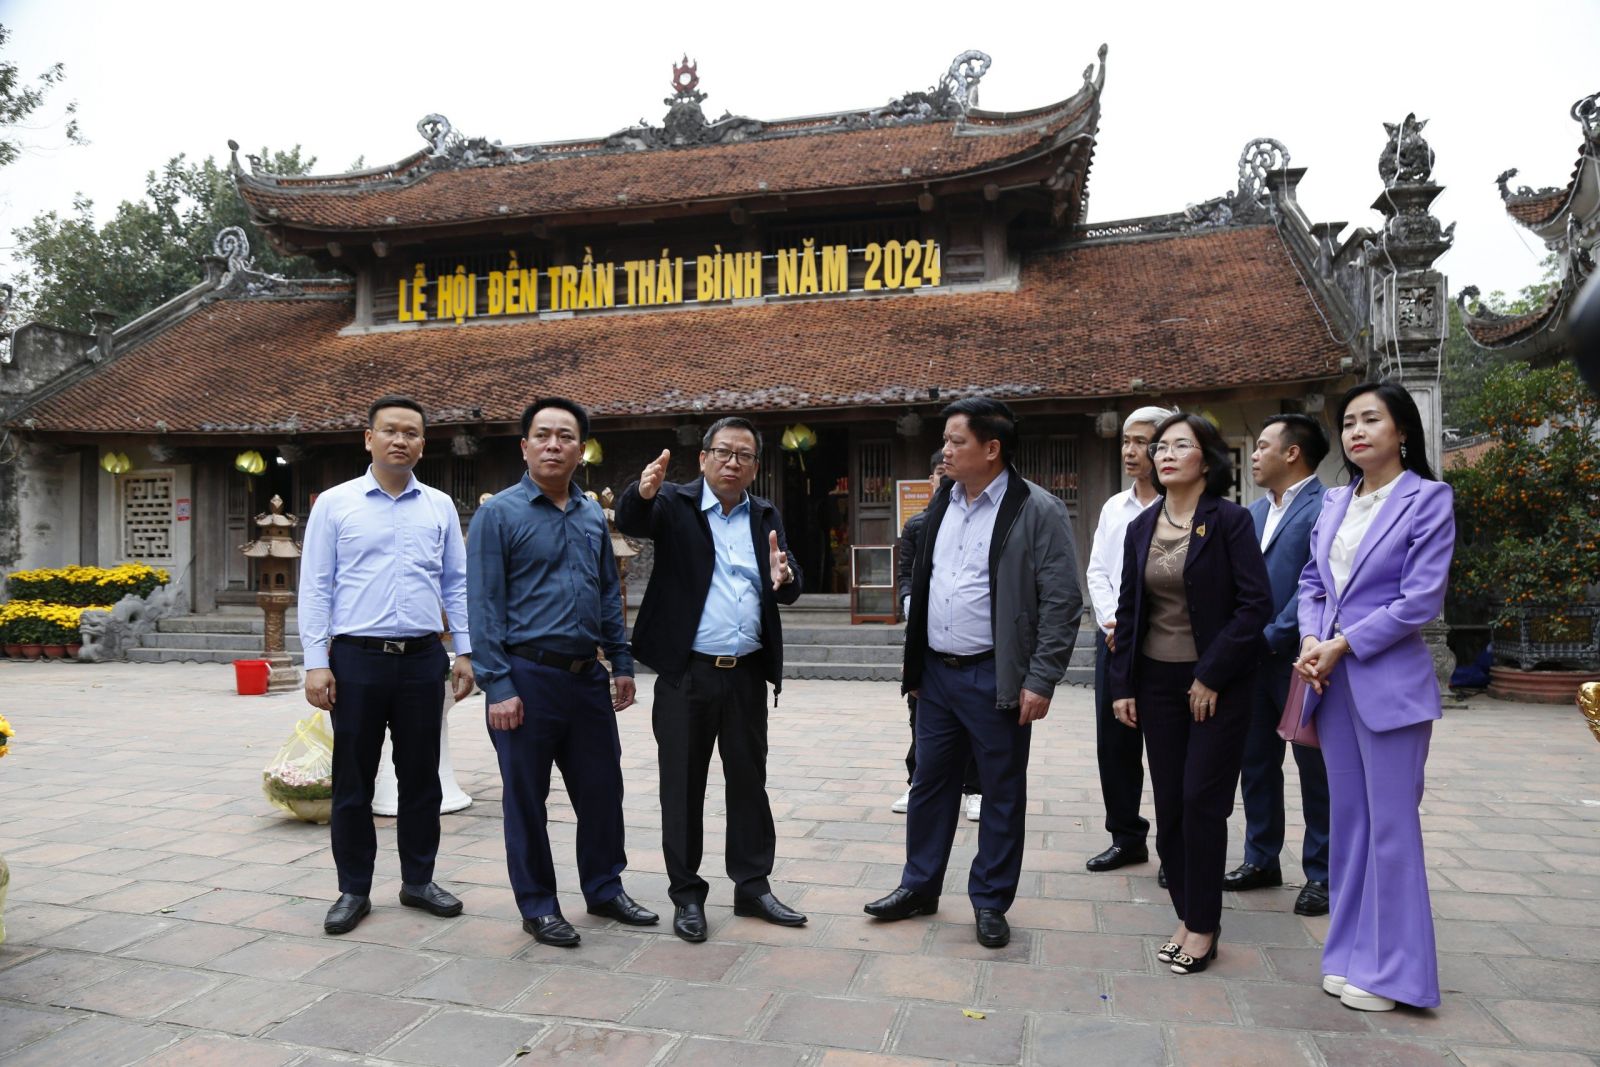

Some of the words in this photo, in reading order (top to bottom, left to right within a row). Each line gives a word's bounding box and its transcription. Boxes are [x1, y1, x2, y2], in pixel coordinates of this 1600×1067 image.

[398, 263, 428, 322] LỄ
[437, 265, 477, 324] HỘI
[488, 250, 538, 316] ĐỀN
[548, 246, 615, 311] TRẦN
[624, 248, 684, 306] THÁI
[696, 244, 763, 302] BÌNH
[777, 237, 848, 297] NĂM
[863, 239, 941, 292] 2024
